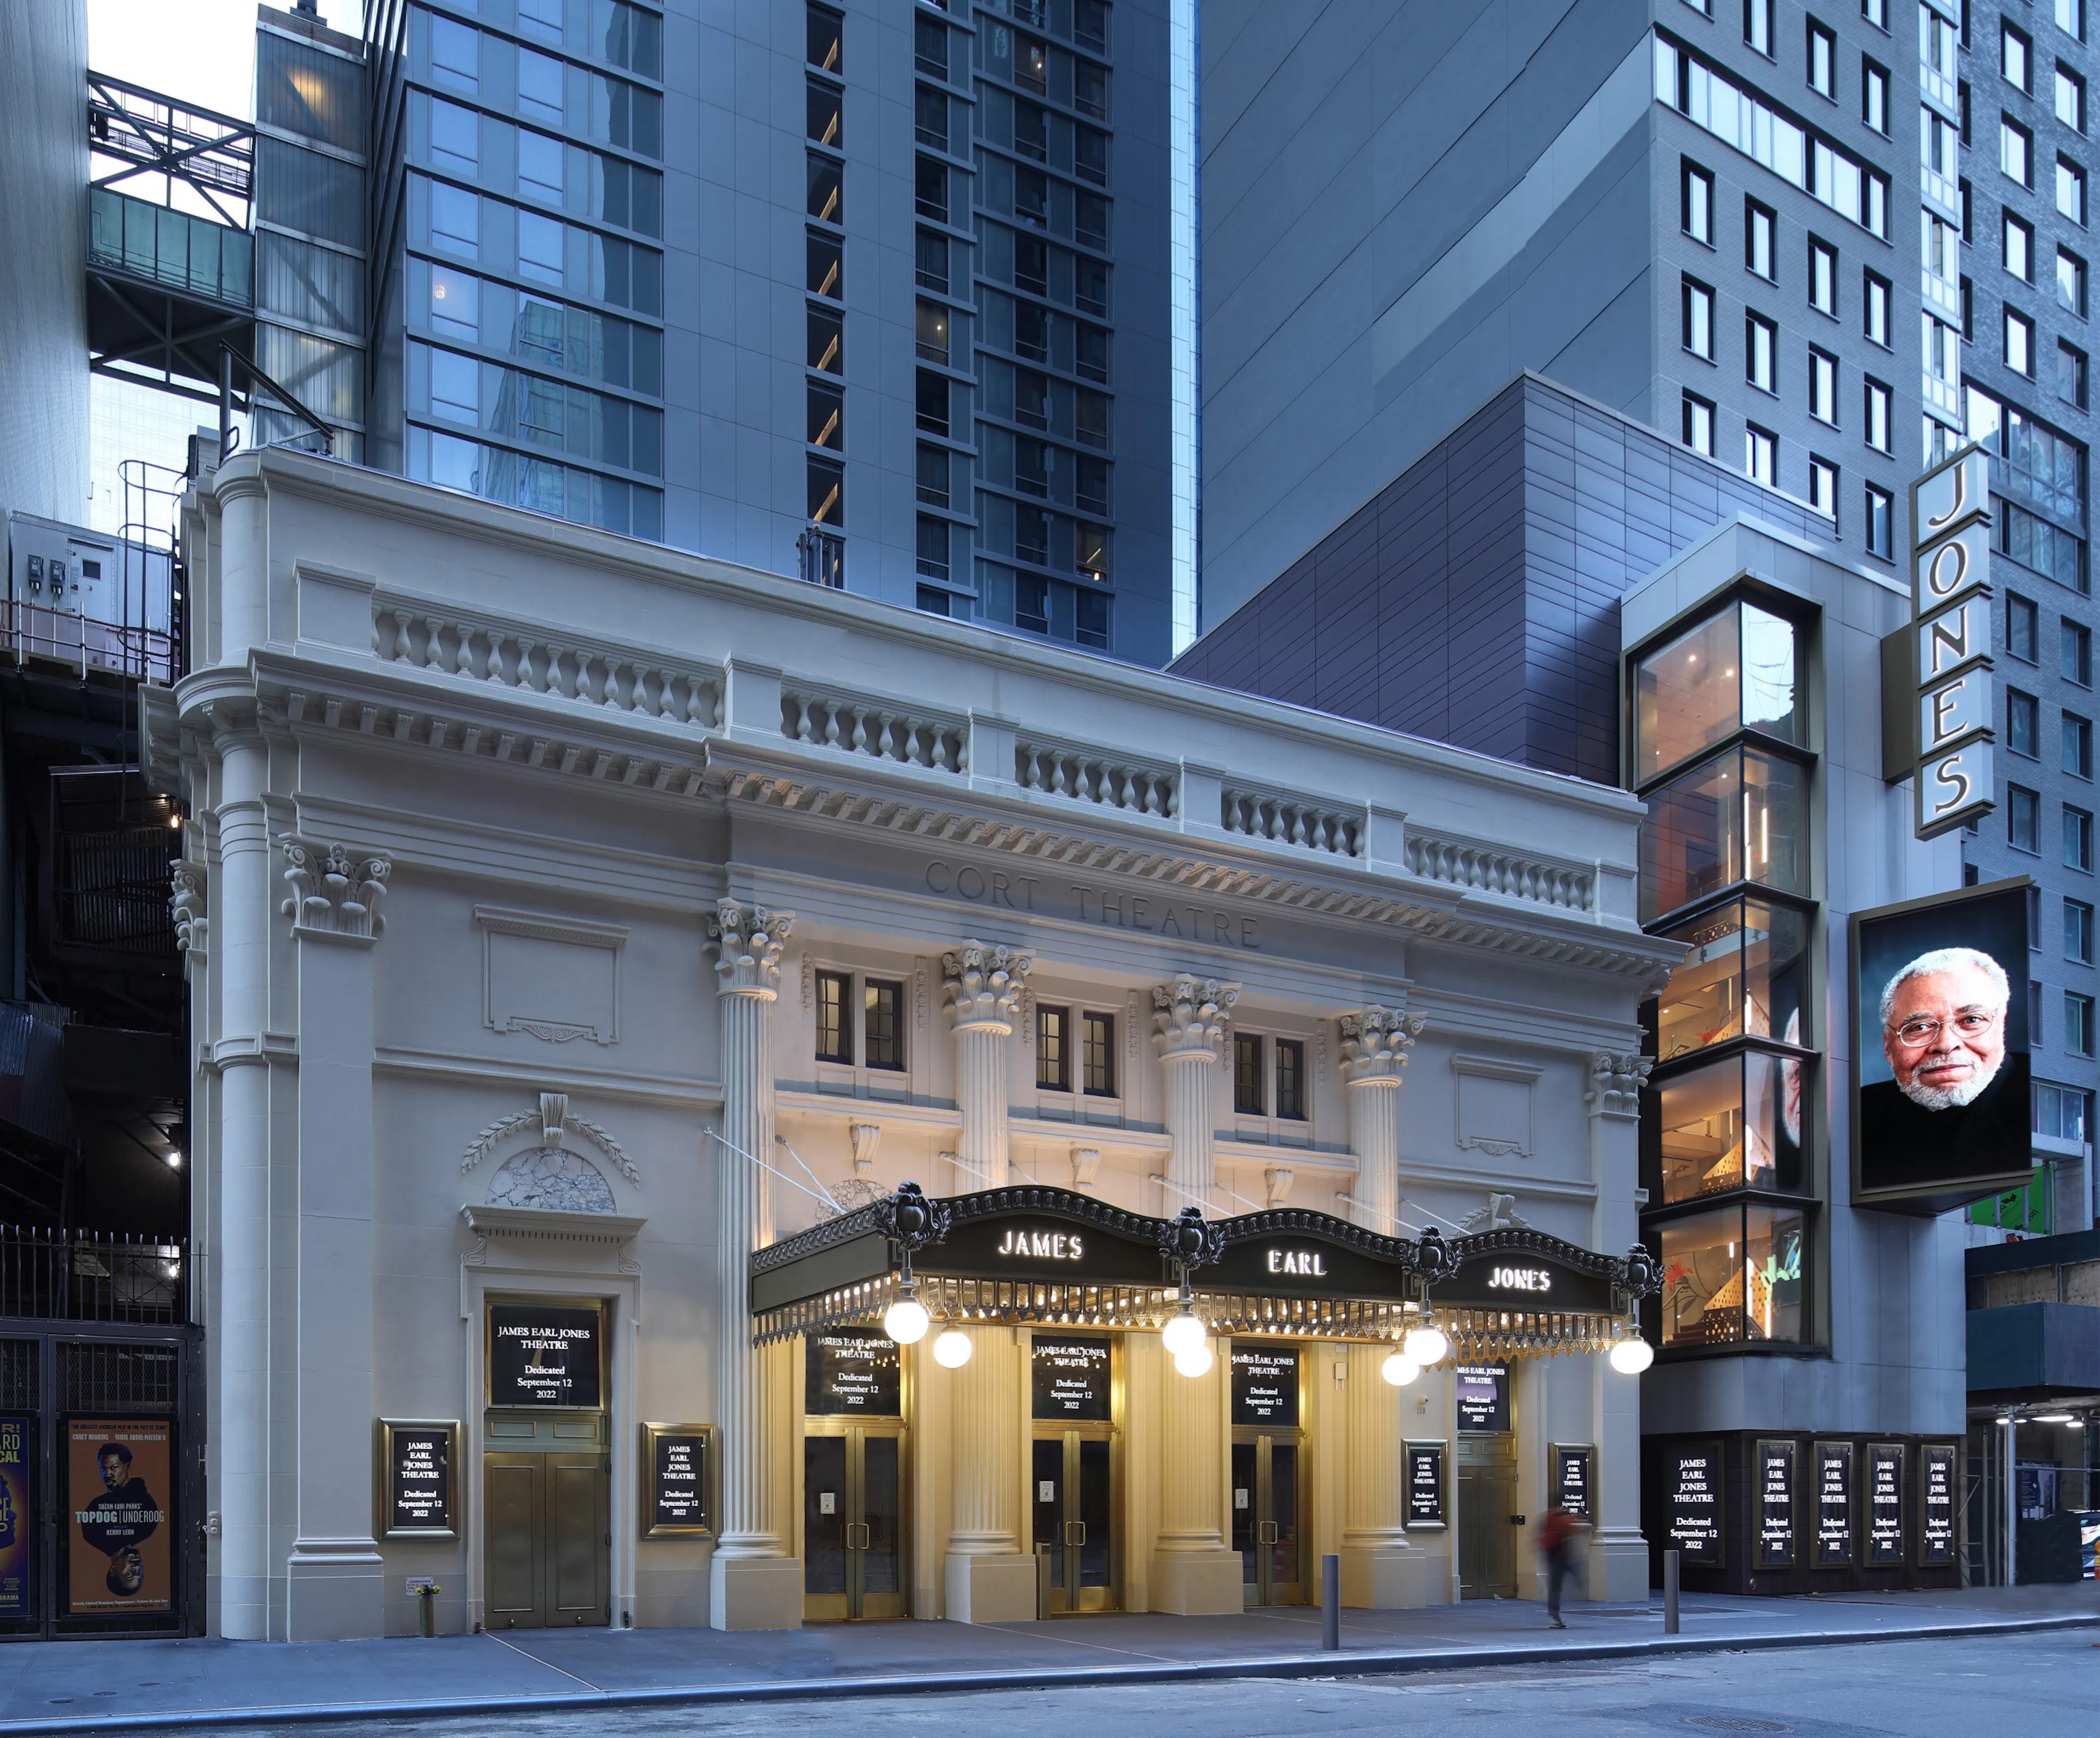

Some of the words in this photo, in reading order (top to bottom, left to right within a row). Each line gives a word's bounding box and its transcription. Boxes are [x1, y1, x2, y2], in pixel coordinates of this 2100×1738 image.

[1927, 461, 1969, 814] JONES
[924, 860, 1041, 910] CORT
[1070, 885, 1262, 949] THEATRE
[998, 1230, 1084, 1259] JAMES
[1268, 1249, 1327, 1276] EARL
[1488, 1267, 1551, 1291] JONES
[498, 1326, 529, 1337] JAMES
[532, 1328, 557, 1337] EARL
[559, 1329, 590, 1339] JONES
[521, 1340, 569, 1349] THEATRE
[818, 1337, 843, 1346] JAMES
[867, 1339, 894, 1349] JONES
[835, 1350, 875, 1358] THEATRE
[1036, 1346, 1060, 1355] JAMES
[1082, 1349, 1105, 1357] JONES
[1053, 1358, 1089, 1366] THEATRE
[1232, 1356, 1254, 1364] JAMES
[1273, 1358, 1294, 1366] JONES
[525, 1366, 564, 1374] Dedicated
[1486, 1368, 1505, 1377] JONES
[838, 1373, 872, 1381] Dedicated
[517, 1378, 560, 1389] September
[1056, 1379, 1087, 1388] Dedicated
[832, 1384, 868, 1394] September
[1051, 1390, 1083, 1399] September
[1245, 1397, 1274, 1407] September
[1462, 1405, 1488, 1414] September
[407, 1462, 433, 1470] JONES
[1679, 1459, 1706, 1469] JAMES
[1767, 1459, 1784, 1468] JAMES
[1824, 1460, 1842, 1469] JAMES
[1877, 1462, 1894, 1471] JAMES
[1930, 1463, 1946, 1472] JAMES
[1679, 1483, 1707, 1492] JONES
[1767, 1483, 1785, 1492] JONES
[1824, 1484, 1842, 1493] JONES
[1877, 1484, 1894, 1494] JONES
[1930, 1485, 1946, 1494] JONES
[660, 1500, 690, 1508] September
[75, 1511, 118, 1524] TOPDOG
[122, 1510, 165, 1523] UNDERDOG
[1671, 1529, 1707, 1538] September
[1762, 1530, 1785, 1540] September
[1819, 1530, 1842, 1540] September
[1872, 1530, 1894, 1539] September
[1926, 1530, 1946, 1539] September
